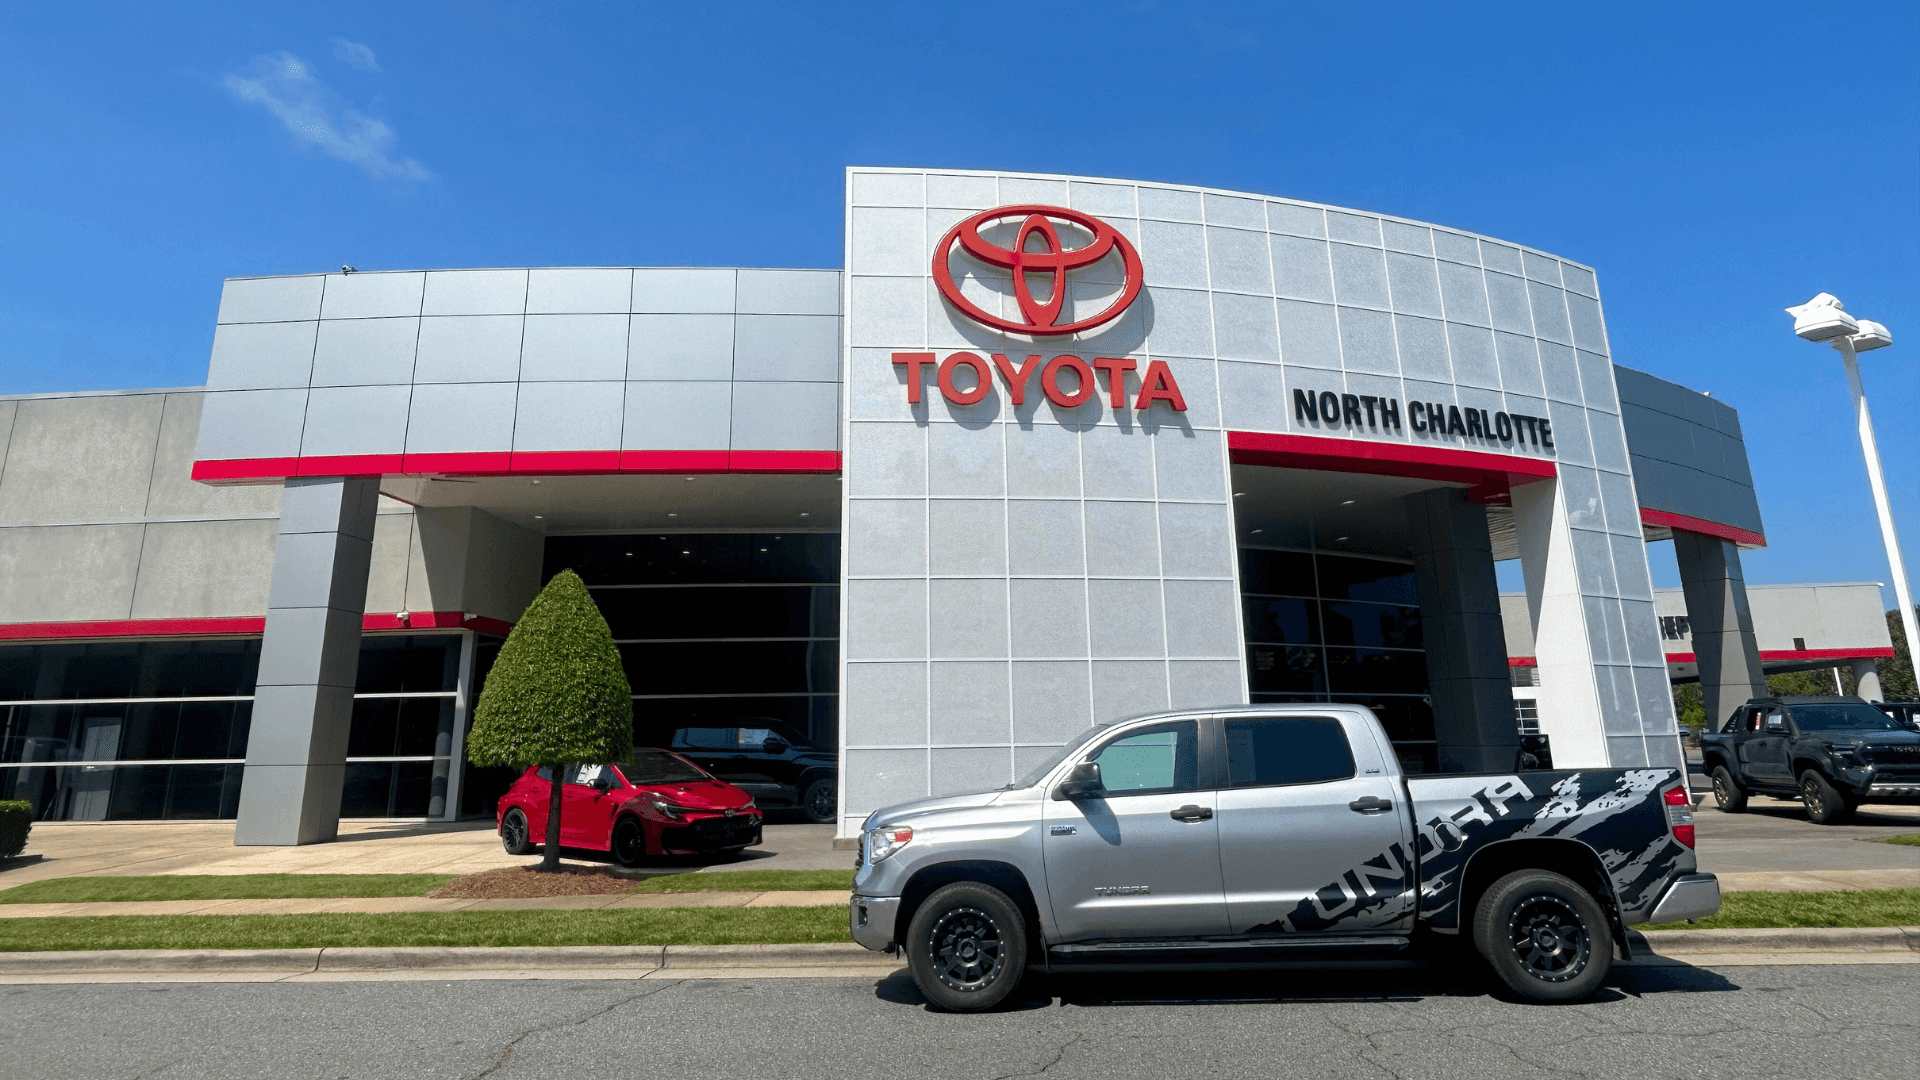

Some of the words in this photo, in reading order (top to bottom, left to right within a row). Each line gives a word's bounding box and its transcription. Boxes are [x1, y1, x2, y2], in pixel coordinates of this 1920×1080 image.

[892, 351, 1187, 411] TOYOTA
[1293, 388, 1400, 430] NORTH
[1407, 400, 1554, 448] CHARLOTTE
[1094, 885, 1150, 897] TUNDRA
